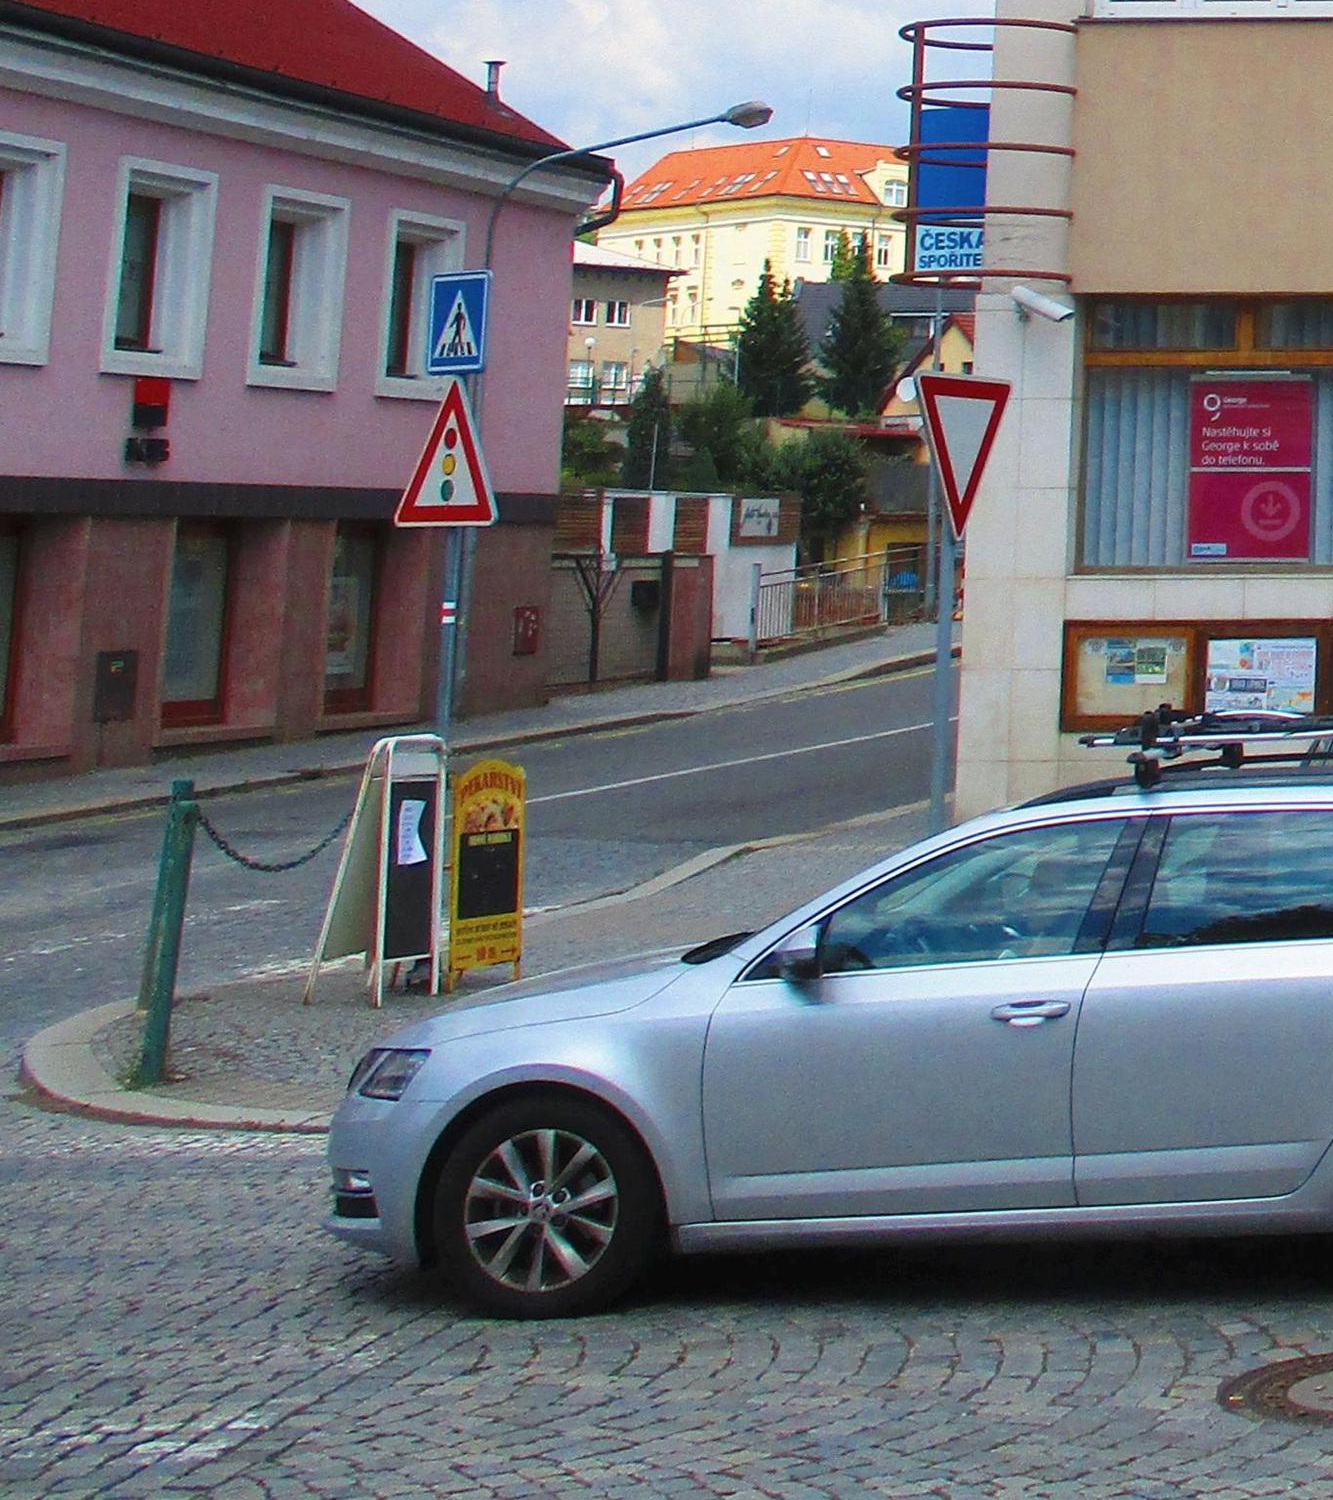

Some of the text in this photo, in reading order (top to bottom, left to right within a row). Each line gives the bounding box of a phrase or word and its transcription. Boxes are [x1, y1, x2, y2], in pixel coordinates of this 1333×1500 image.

[1202, 426, 1260, 439] Nastěhujte
[1202, 439, 1279, 452] George k sobě
[1202, 454, 1216, 465] do
